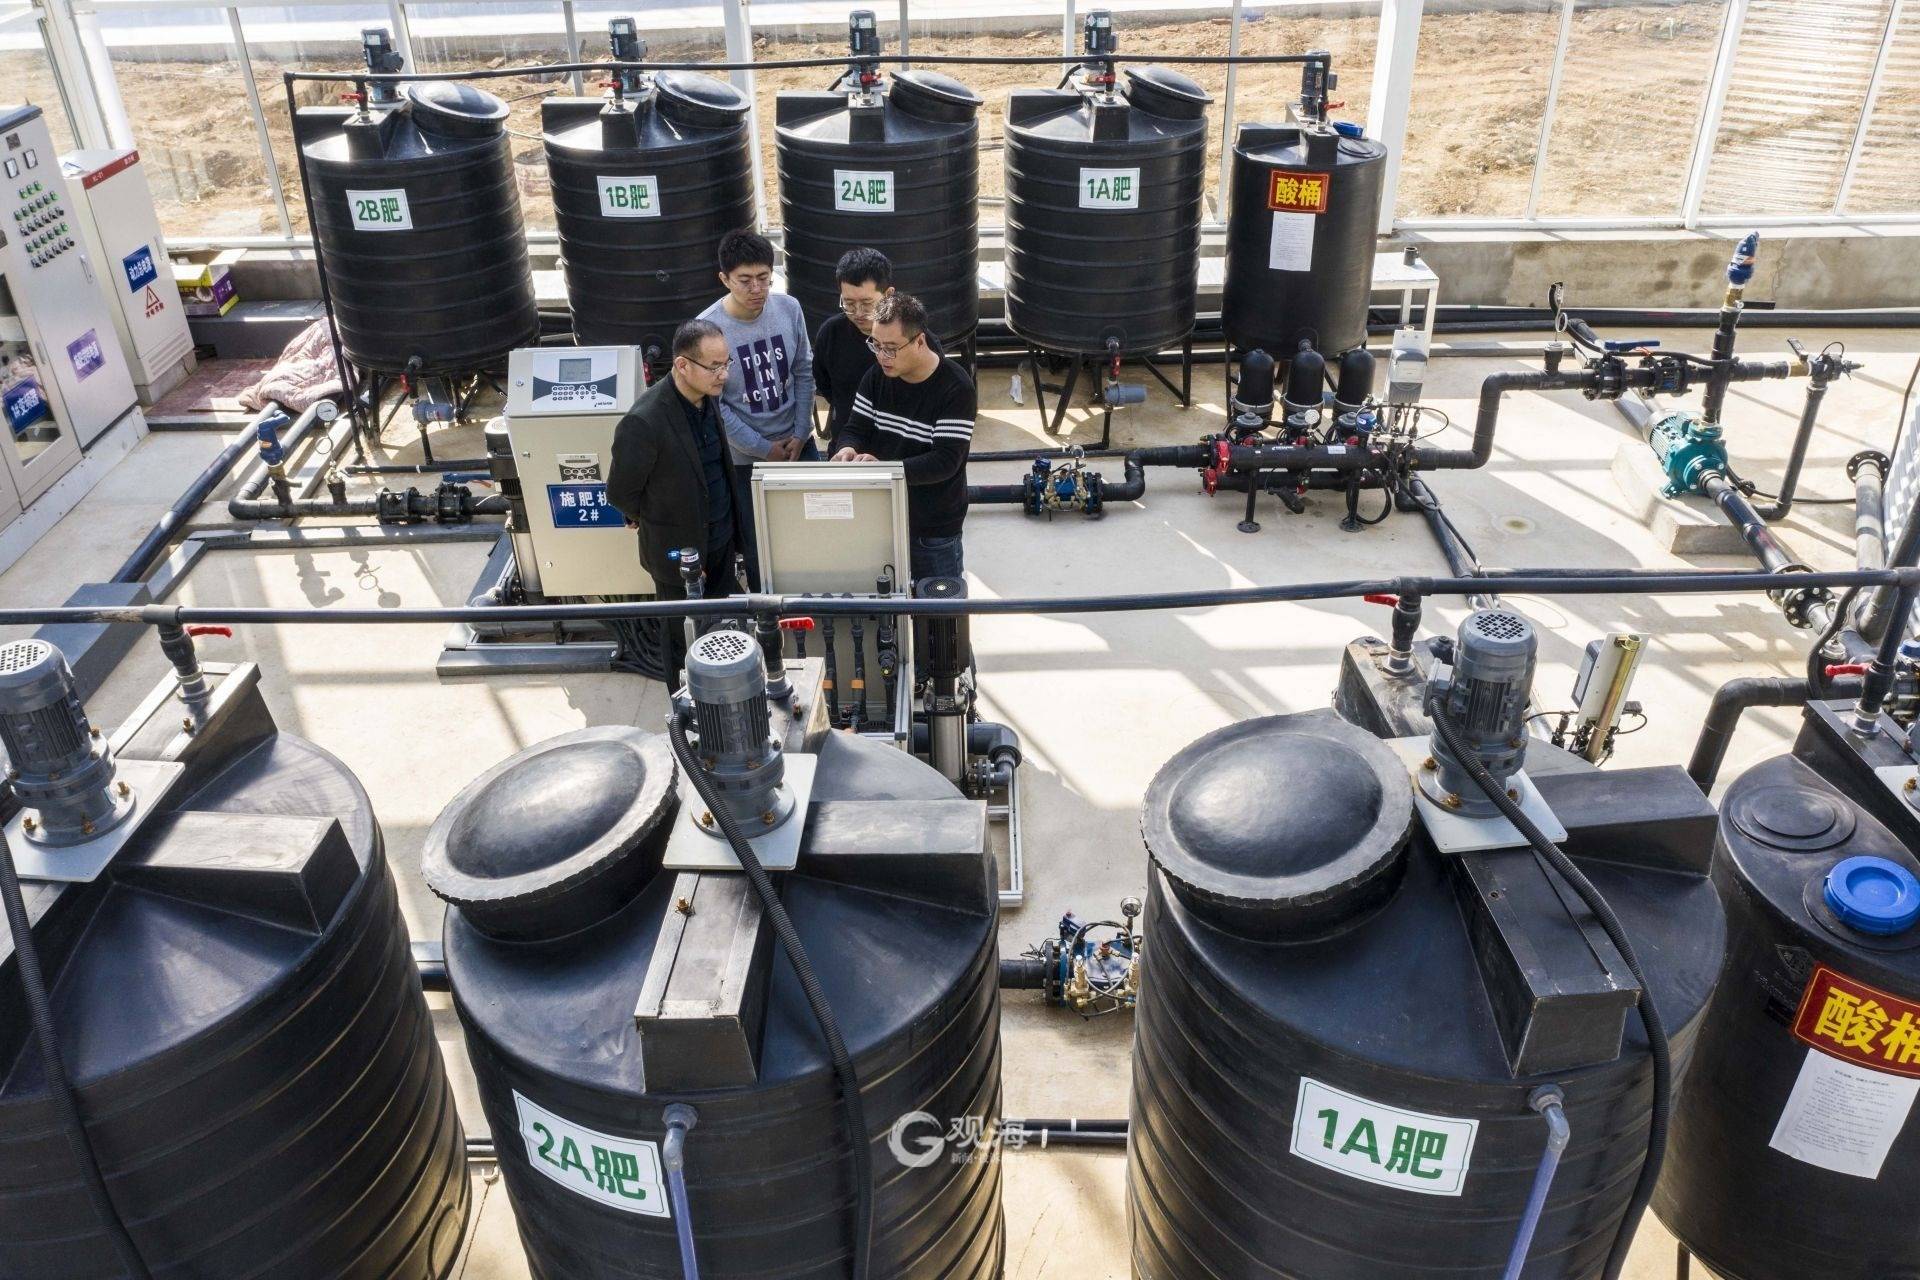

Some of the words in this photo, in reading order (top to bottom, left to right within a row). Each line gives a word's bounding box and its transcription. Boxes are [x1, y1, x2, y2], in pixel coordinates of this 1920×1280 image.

[605, 184, 650, 210] 1B肥
[841, 179, 887, 204] 2A肥
[1087, 176, 1131, 201] 1A肥
[1275, 178, 1322, 206] 酸桶
[355, 197, 403, 223] 2B肥
[743, 347, 784, 370] TOYS
[758, 368, 775, 383] IN
[742, 379, 789, 403] ACTI
[578, 509, 599, 522] 2#
[1317, 1108, 1449, 1180] 1A肥
[532, 1121, 647, 1200] 2A肥
